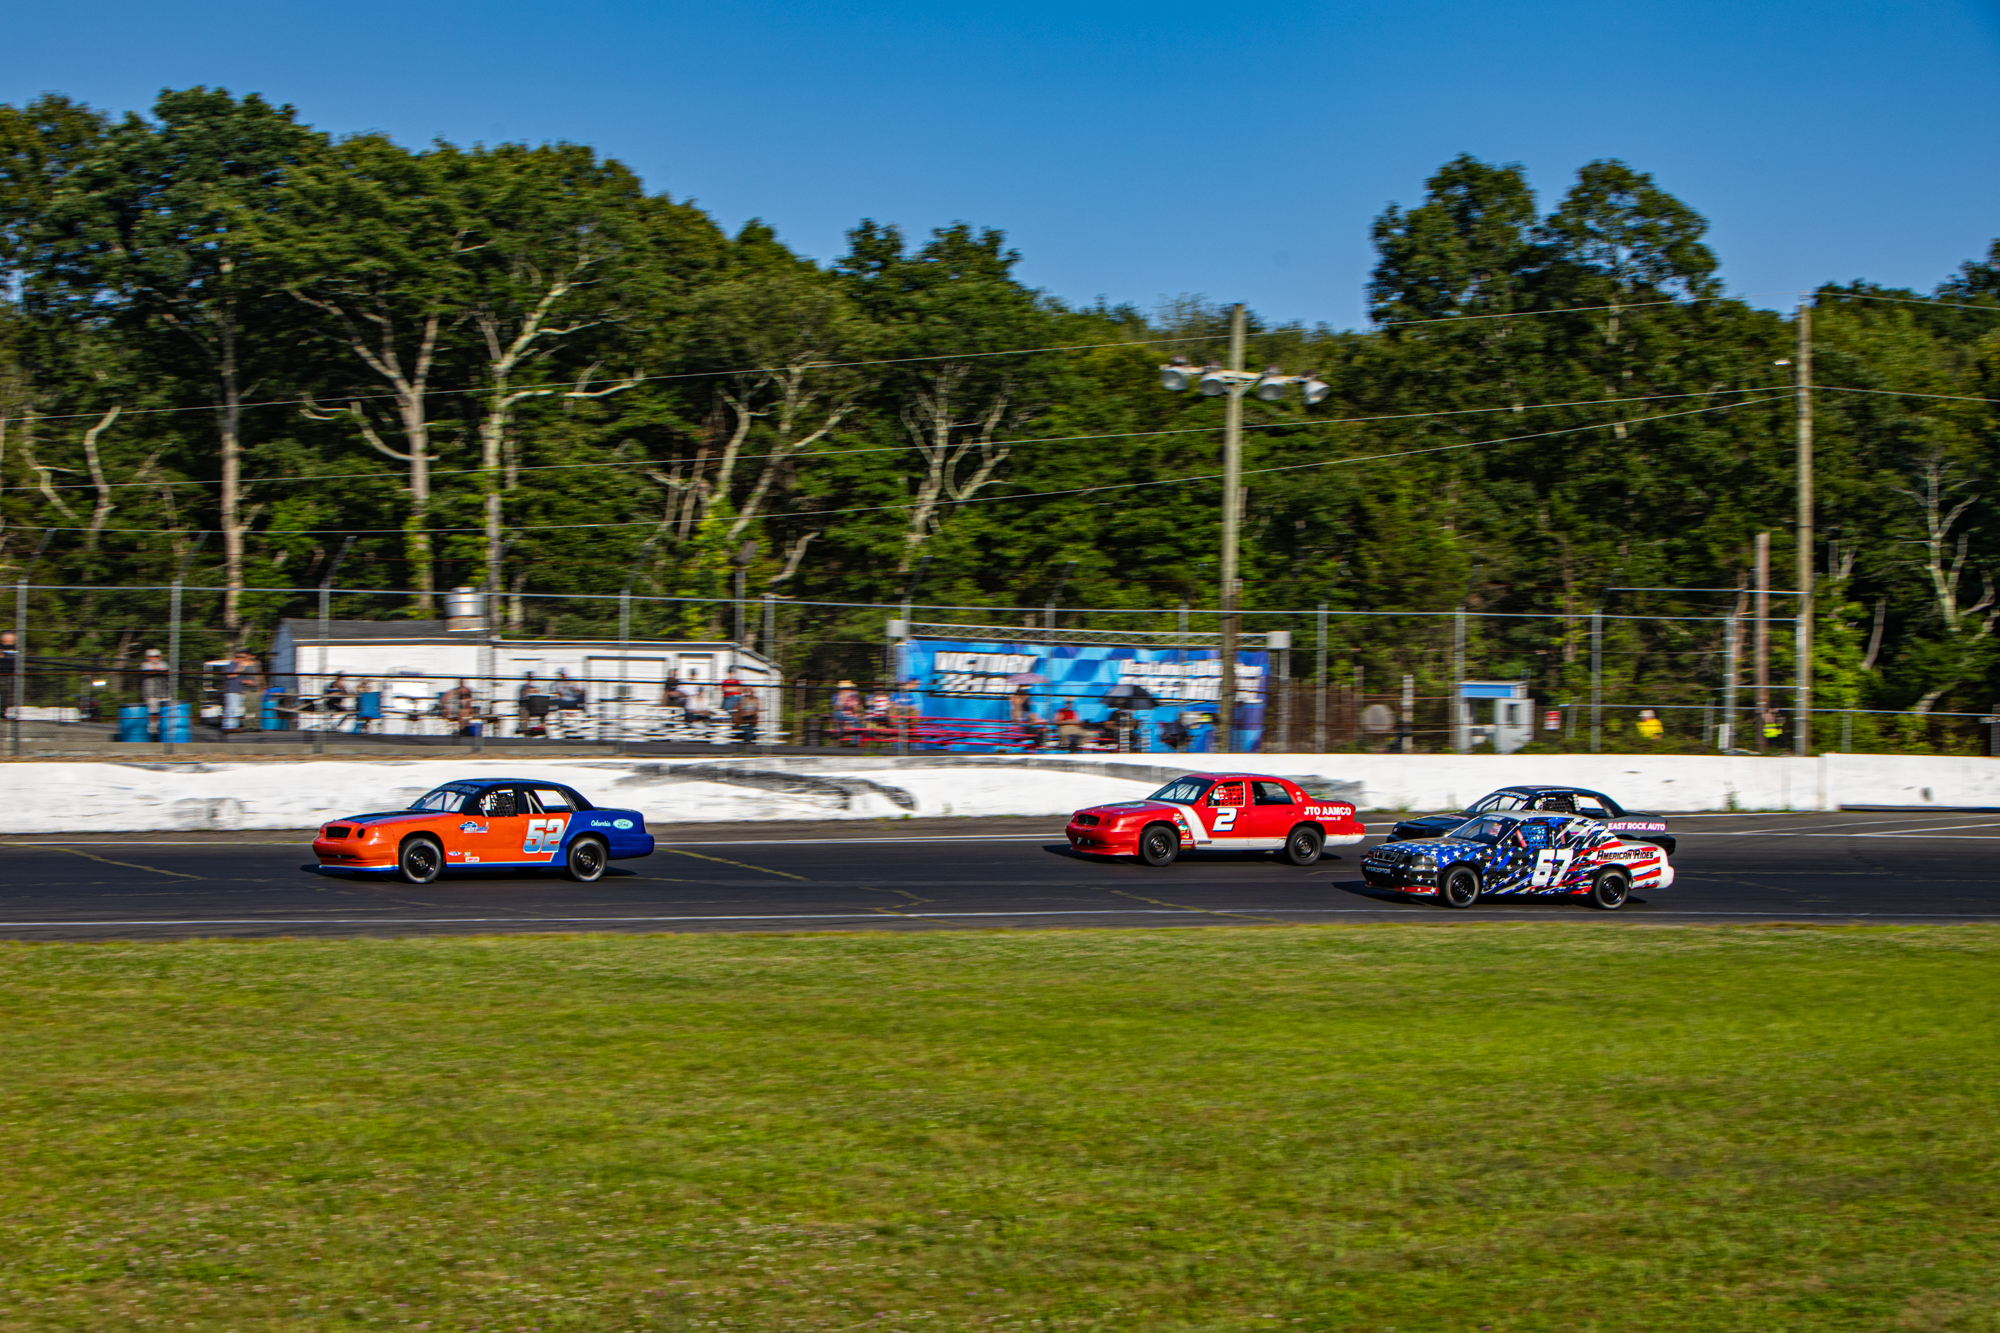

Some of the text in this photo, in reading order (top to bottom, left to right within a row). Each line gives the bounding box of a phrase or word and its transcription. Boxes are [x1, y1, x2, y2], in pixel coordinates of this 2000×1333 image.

[1304, 806, 1351, 816] JTO AAMCO
[590, 819, 611, 827] Columbia
[1212, 808, 1238, 832] 2
[1607, 822, 1666, 831] EAST ROCK AUTO
[523, 818, 565, 854] 52
[1531, 848, 1574, 886] 67
